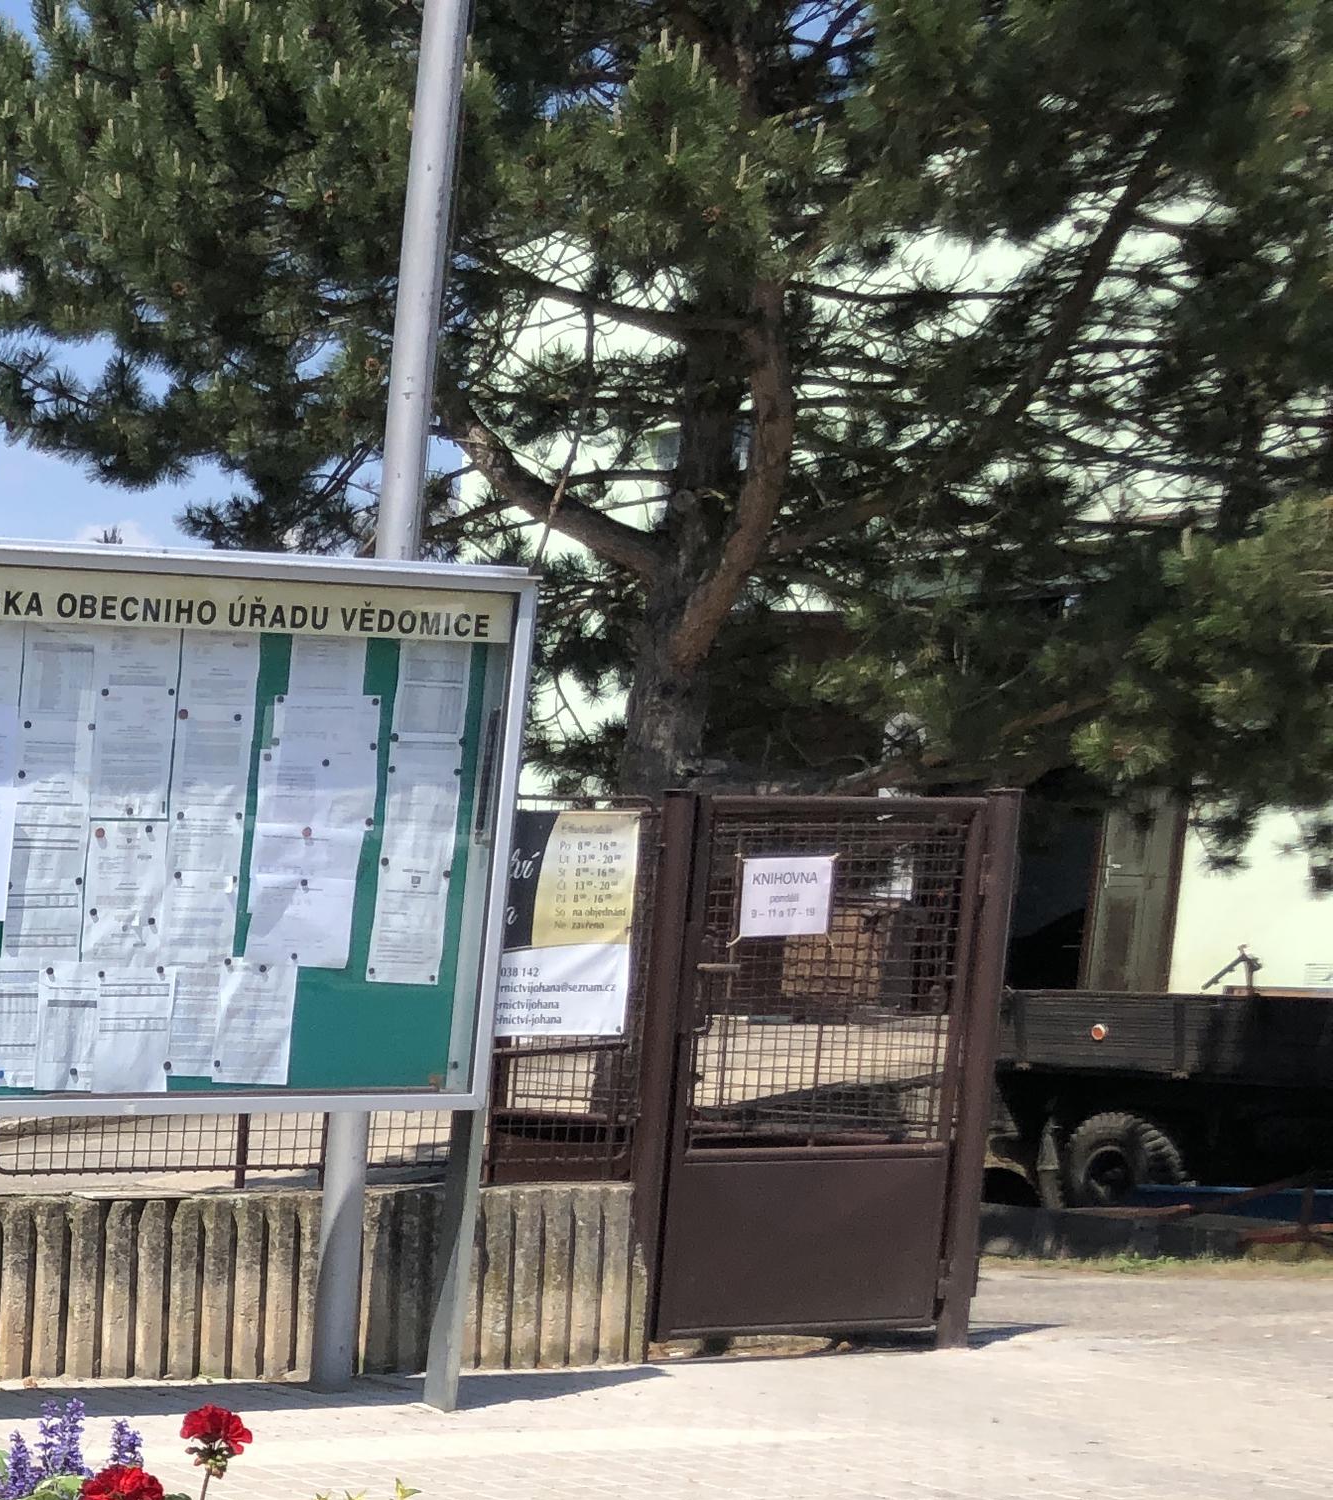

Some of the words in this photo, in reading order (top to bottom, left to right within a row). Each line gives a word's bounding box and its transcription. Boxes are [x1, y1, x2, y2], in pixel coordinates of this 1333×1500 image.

[56, 592, 217, 627] OBECNIHO
[228, 595, 329, 631] ÚŘADU
[341, 600, 490, 638] VĚDOMICE
[752, 872, 818, 885] KNIHOVNA
[767, 909, 777, 918] 11
[786, 908, 797, 917] 17
[521, 967, 539, 977] 142
